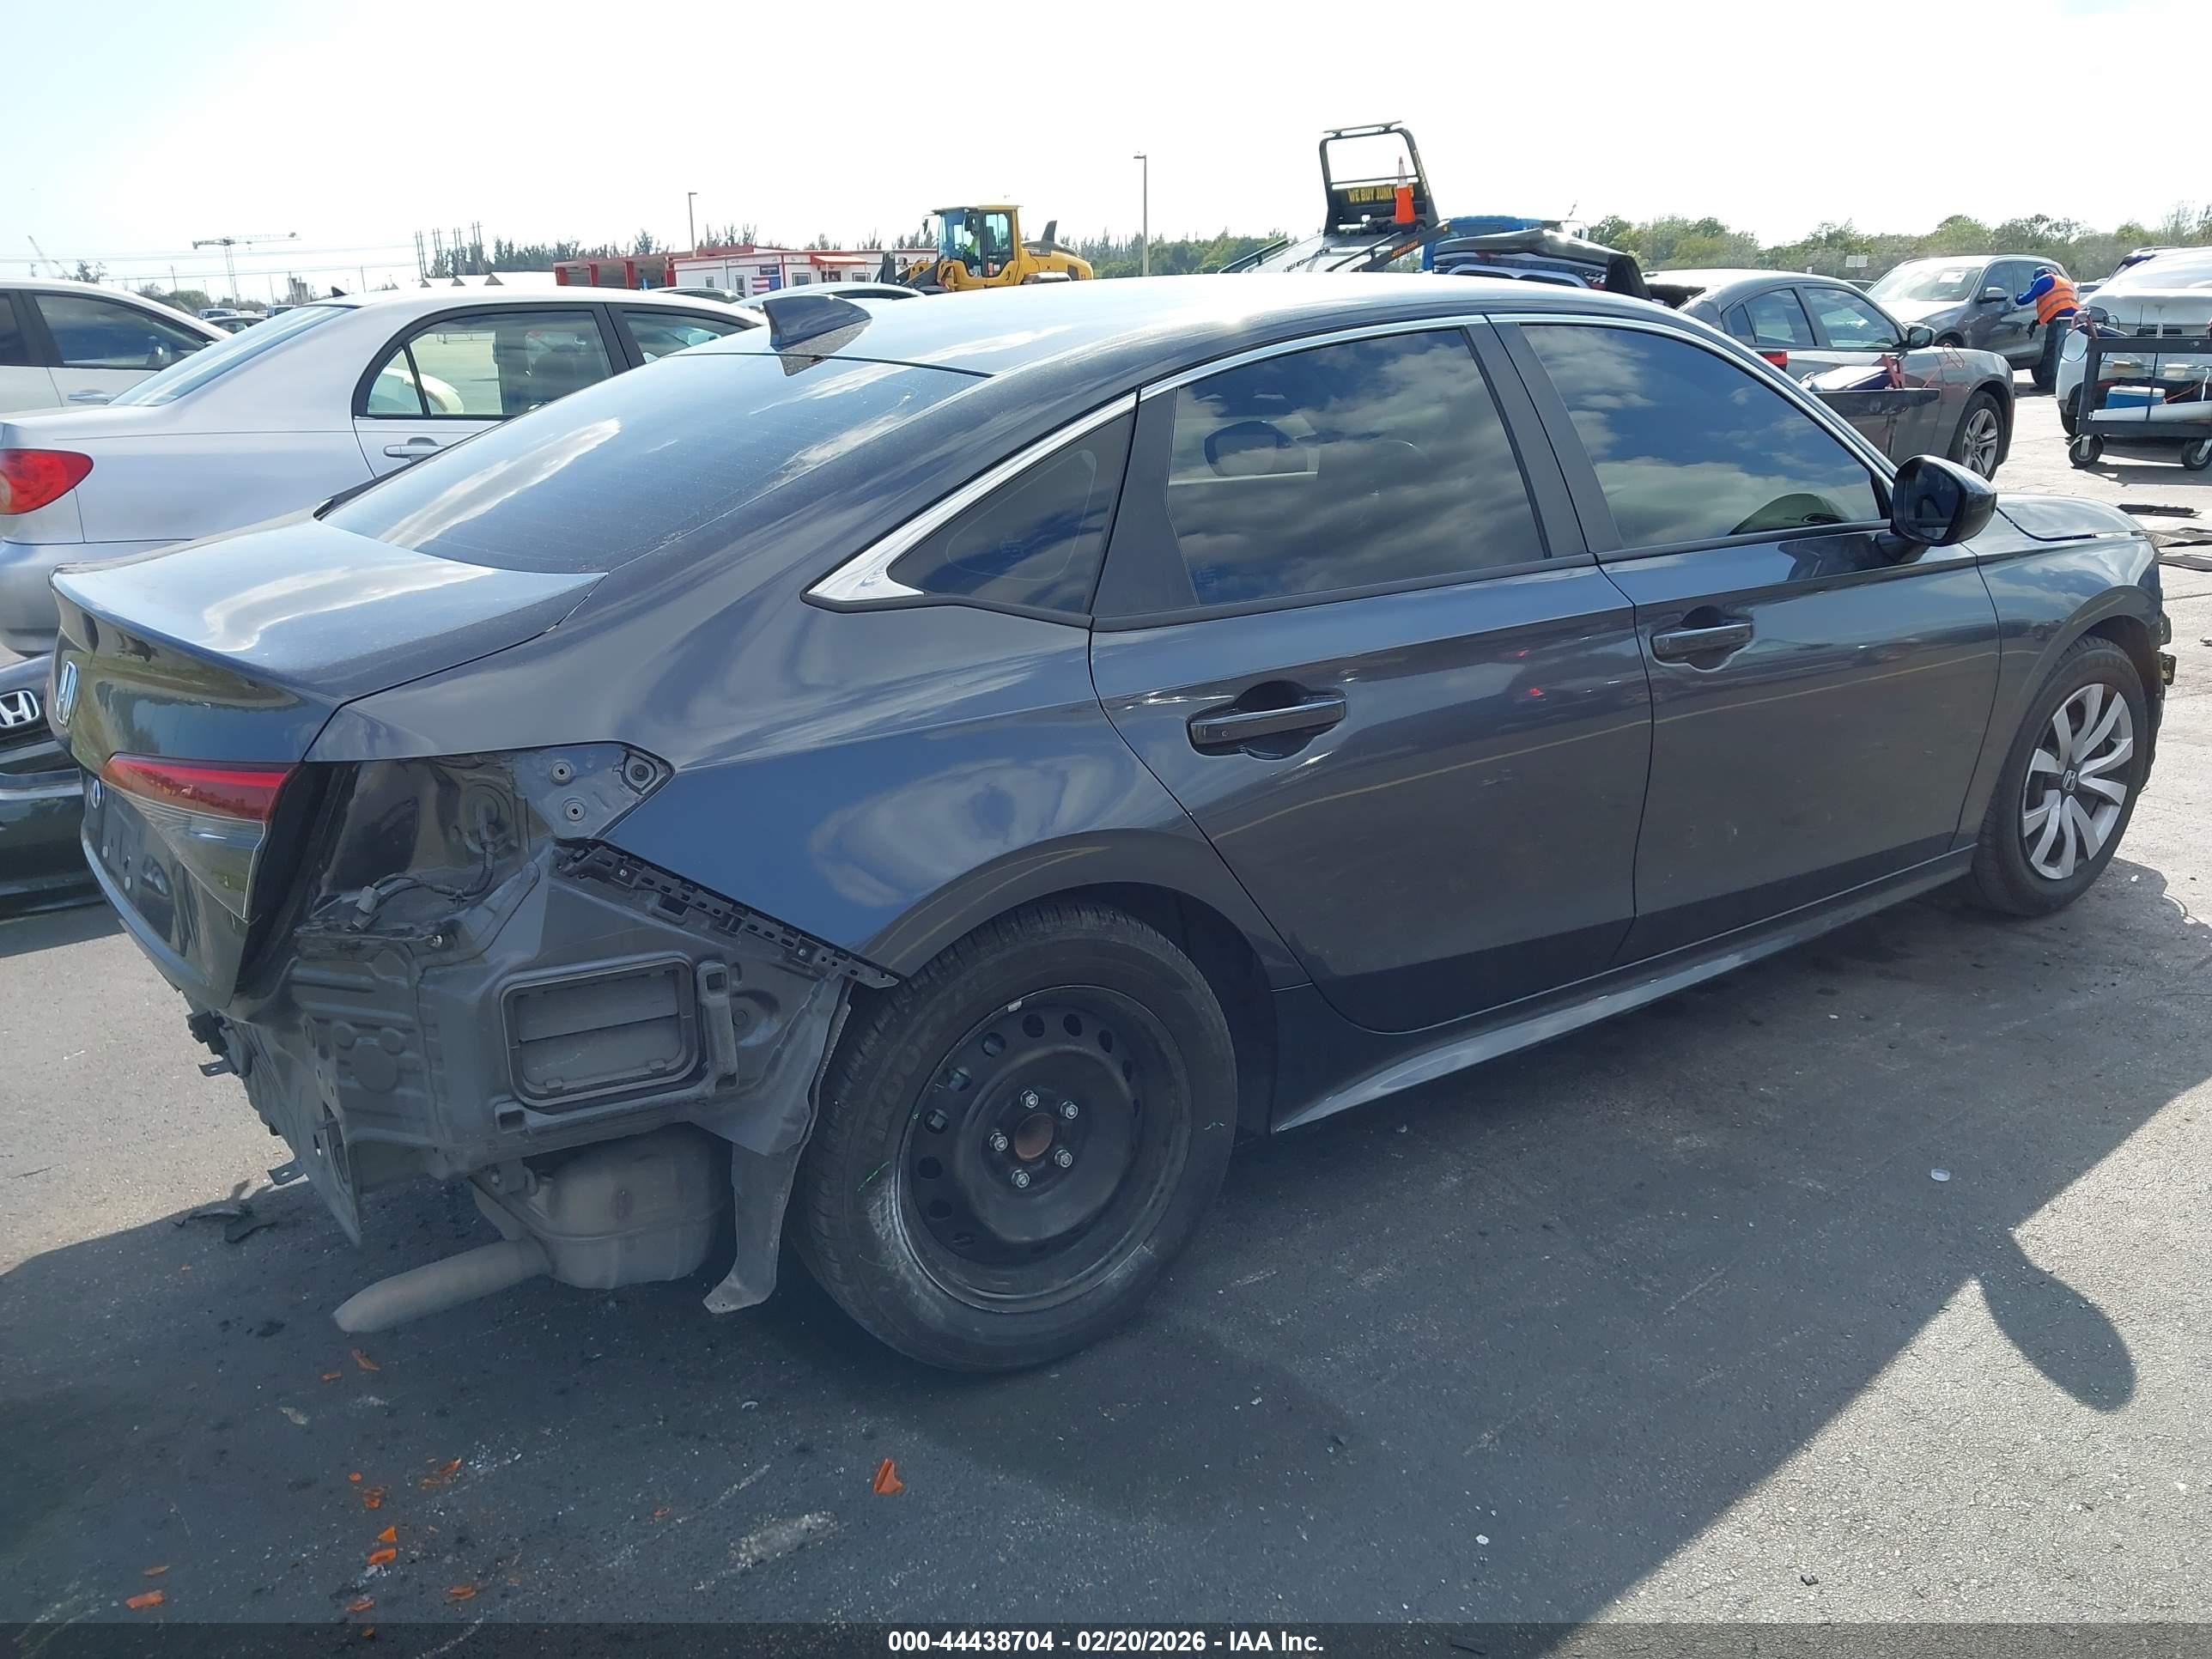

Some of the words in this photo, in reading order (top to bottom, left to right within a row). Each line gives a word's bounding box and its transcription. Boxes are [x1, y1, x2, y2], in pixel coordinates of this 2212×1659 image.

[1347, 187, 1360, 203] WE
[1360, 186, 1374, 202] BUY
[1376, 184, 1393, 200] JUNK
